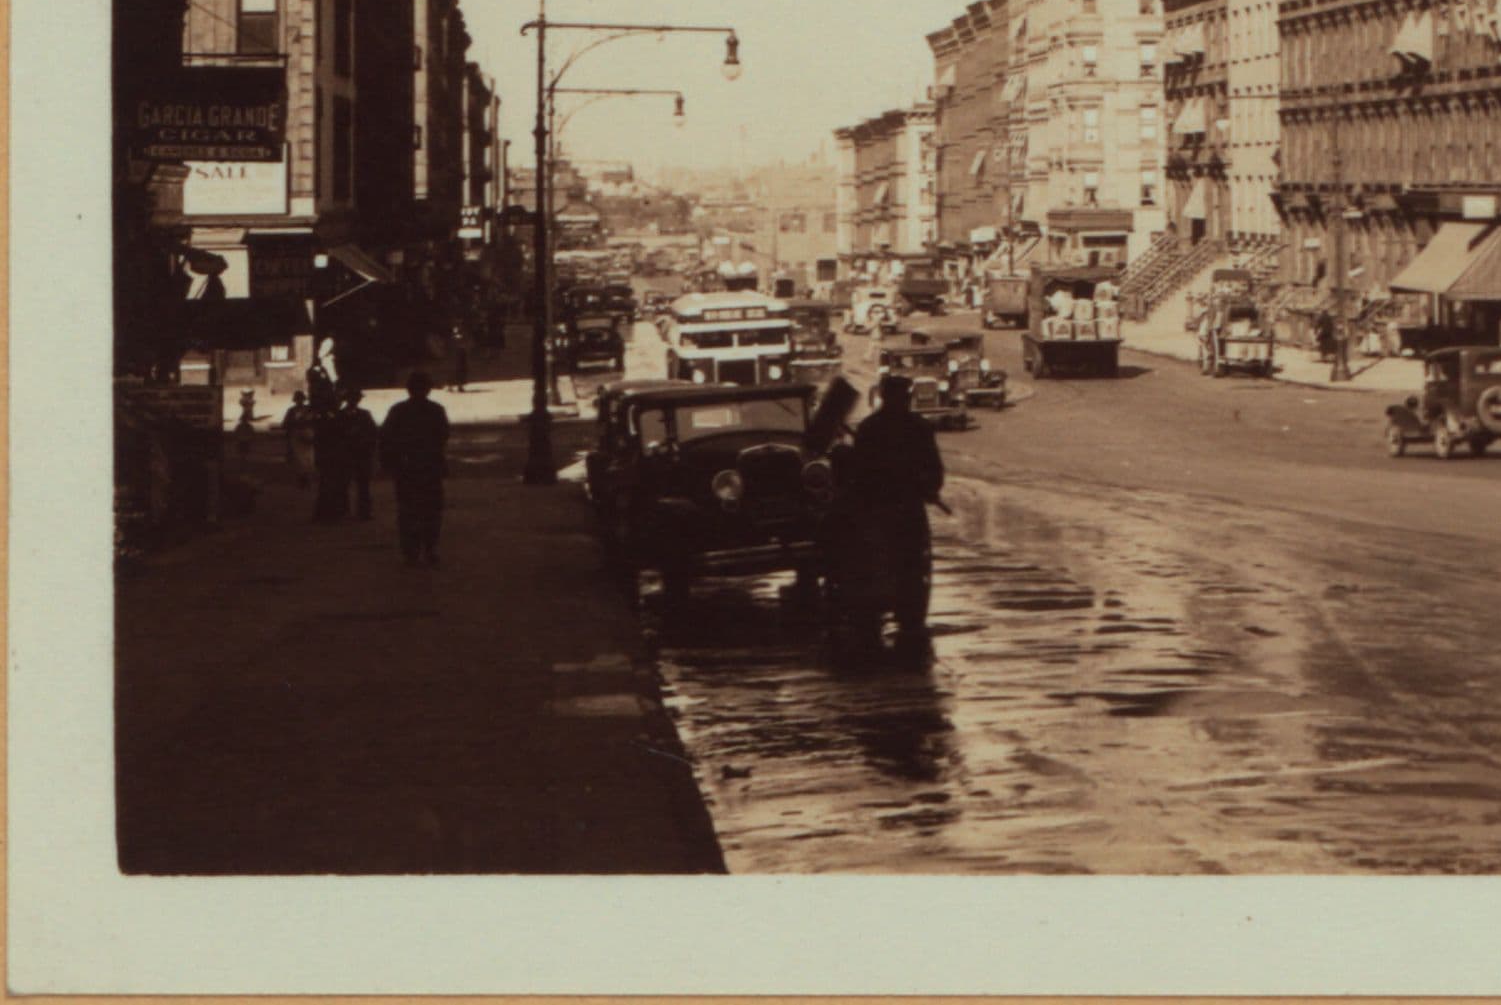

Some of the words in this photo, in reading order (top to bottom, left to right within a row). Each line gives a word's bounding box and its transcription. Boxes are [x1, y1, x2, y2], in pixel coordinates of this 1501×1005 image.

[138, 101, 202, 128] GARCIA
[209, 104, 280, 130] GRANDE
[159, 129, 257, 142] CIGAR
